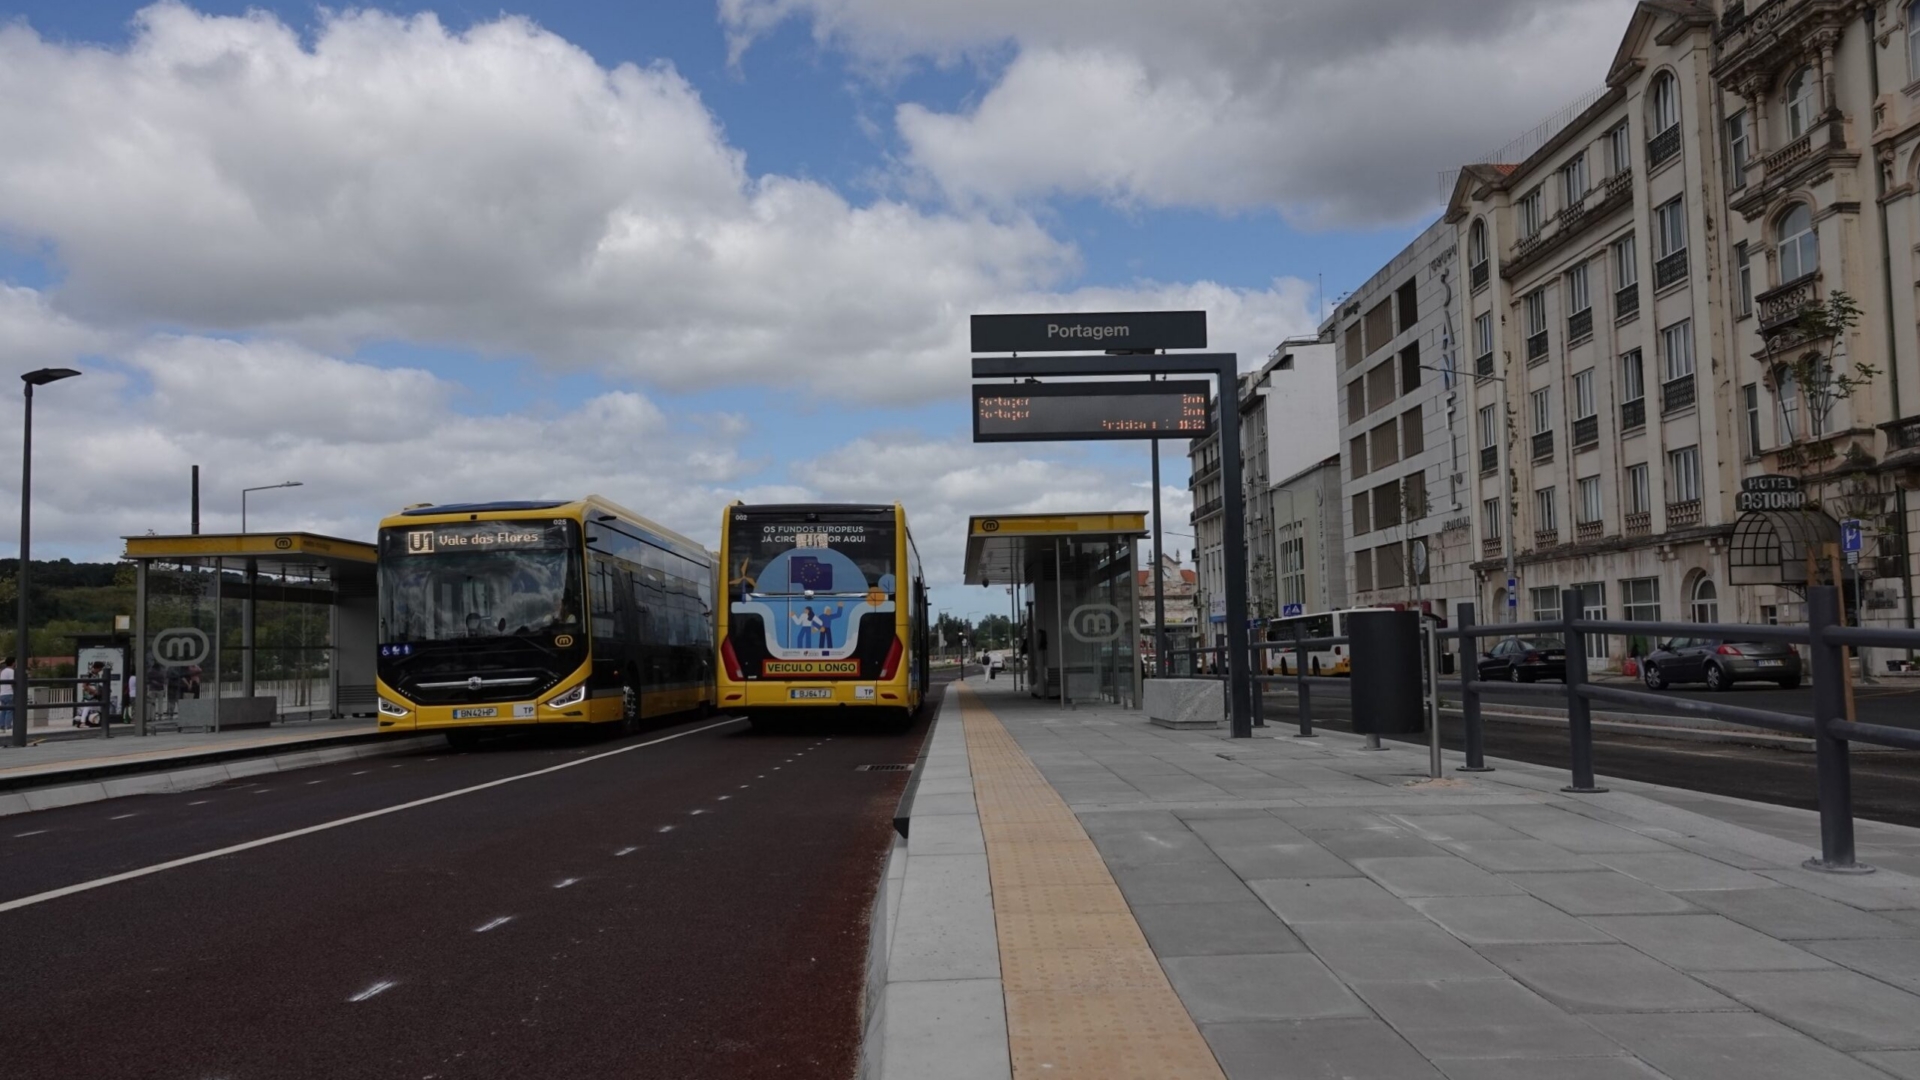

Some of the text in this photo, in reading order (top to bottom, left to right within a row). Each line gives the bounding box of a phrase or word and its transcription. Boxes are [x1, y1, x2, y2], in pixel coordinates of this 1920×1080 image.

[1047, 323, 1130, 341] Portagem
[1748, 477, 1795, 490] HOTEL
[1741, 491, 1806, 509] ASTORIA
[409, 532, 538, 551] U1 Vale das Flores
[761, 534, 772, 543] JÁ
[843, 535, 866, 543] AQUI
[767, 663, 856, 672] VEICULO LONGO
[799, 690, 827, 698] BJ64TJ
[460, 708, 494, 718] BN42HP
